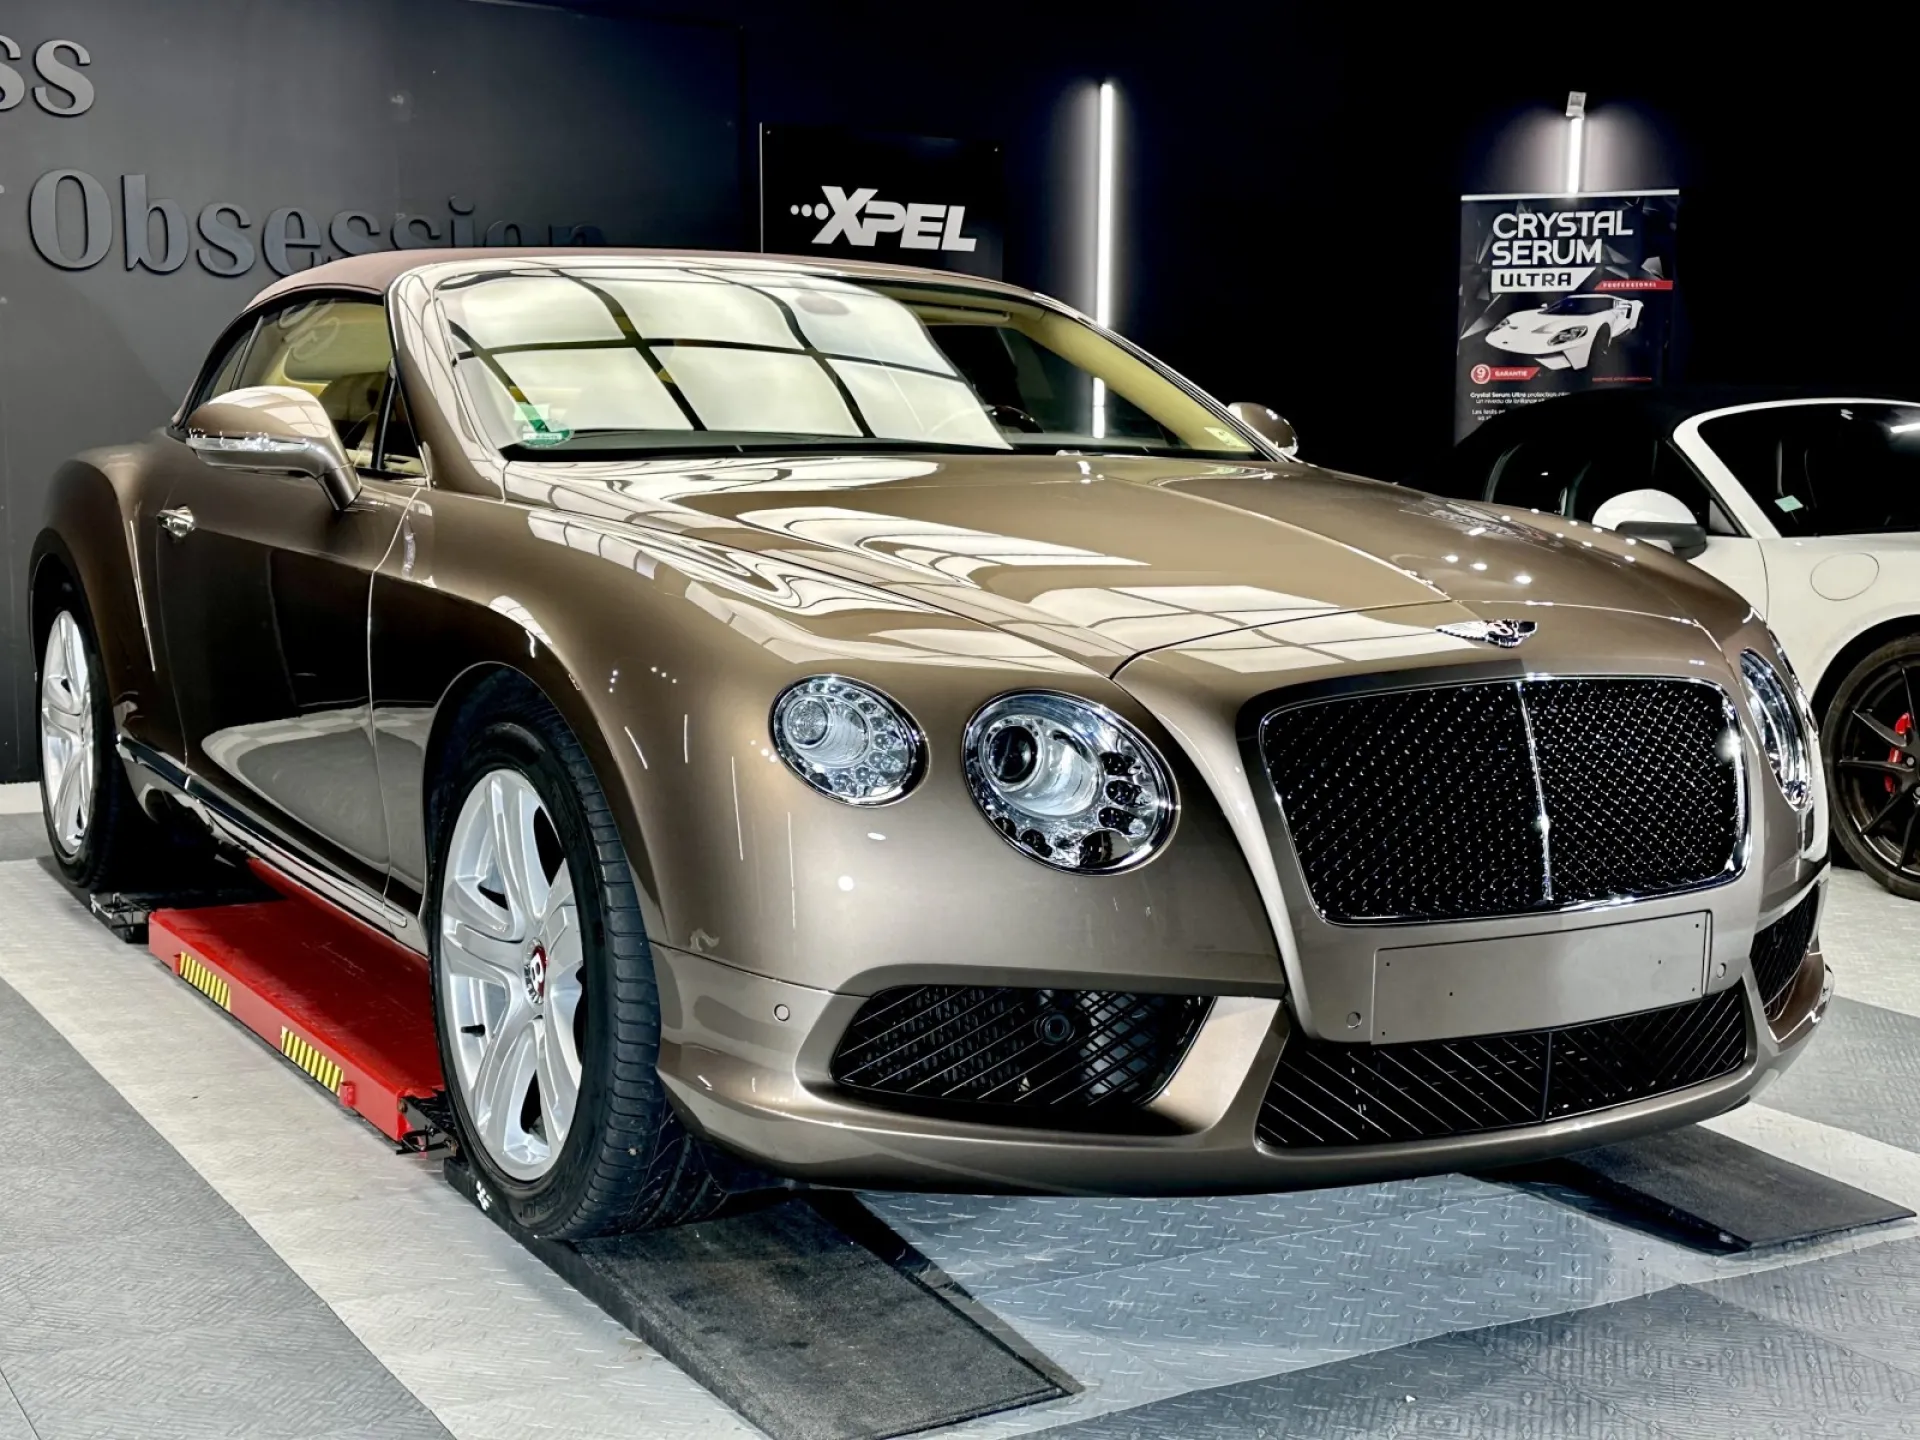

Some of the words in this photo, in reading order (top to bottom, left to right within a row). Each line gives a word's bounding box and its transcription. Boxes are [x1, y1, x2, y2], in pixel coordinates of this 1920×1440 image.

[811, 185, 977, 252] XPEL
[1493, 210, 1634, 239] CRYSTAL
[1492, 239, 1602, 265] SERUM
[1500, 272, 1571, 287] ULTRA
[1470, 391, 1491, 399] Crystal
